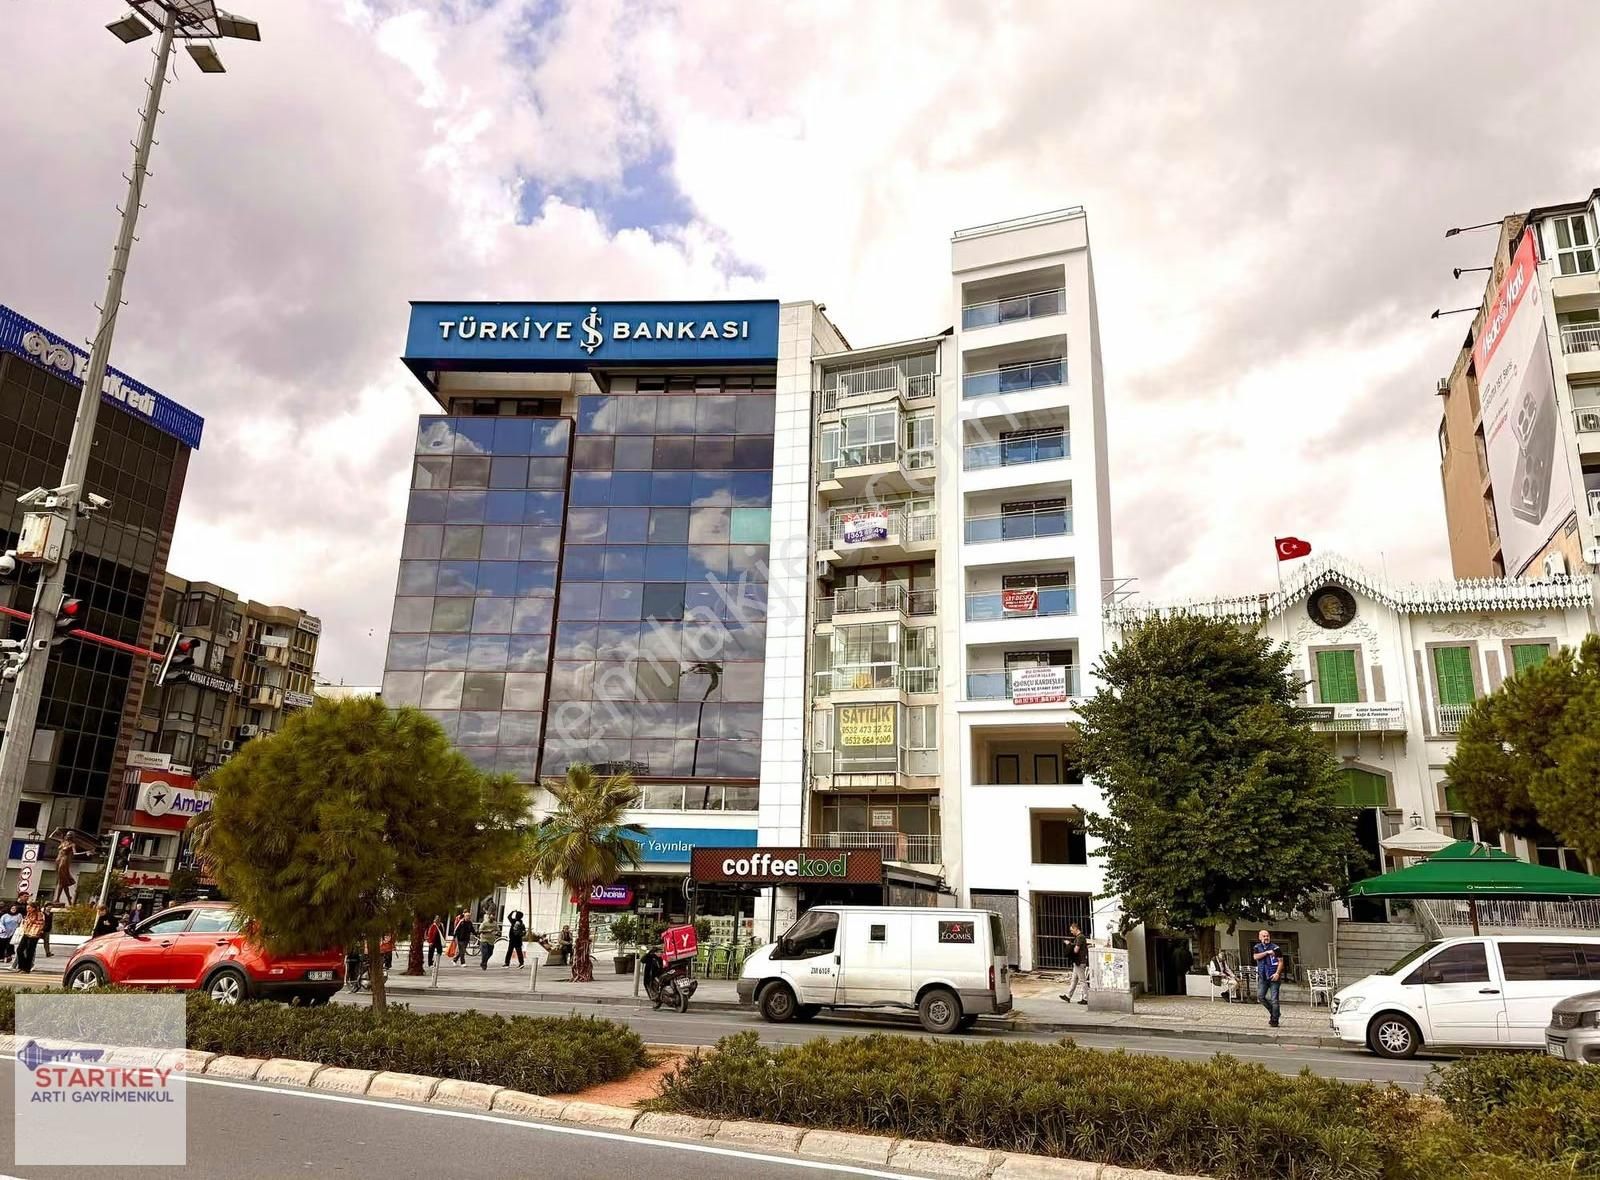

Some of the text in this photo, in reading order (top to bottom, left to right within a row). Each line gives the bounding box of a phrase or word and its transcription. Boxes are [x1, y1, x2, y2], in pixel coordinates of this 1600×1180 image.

[439, 316, 572, 340] TÜRKİYE
[612, 320, 749, 340] BANKASI
[842, 706, 891, 724] SATILIK
[170, 792, 213, 813] Ameri
[722, 853, 847, 877] coffeekod
[681, 933, 689, 947] Y
